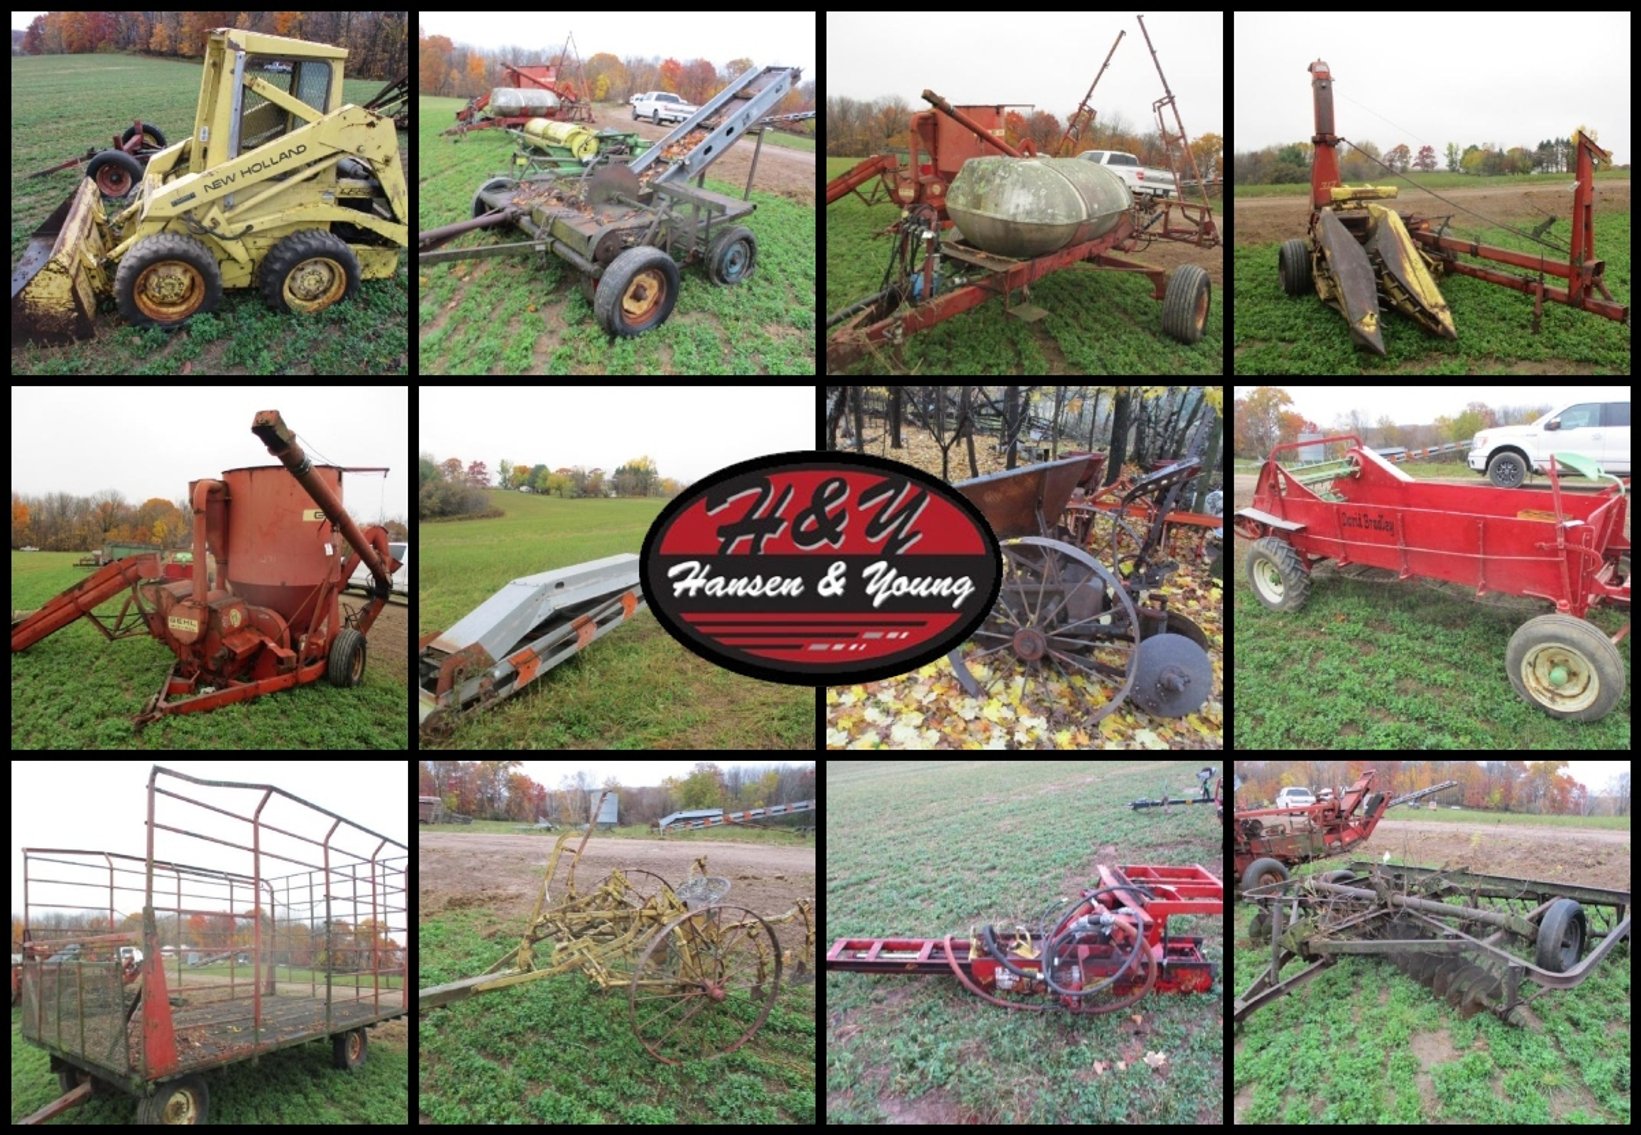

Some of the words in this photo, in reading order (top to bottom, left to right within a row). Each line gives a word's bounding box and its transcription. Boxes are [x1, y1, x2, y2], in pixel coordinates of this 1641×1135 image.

[203, 173, 236, 193] NEW
[240, 144, 307, 178] HOLLAND
[169, 615, 197, 628] GEHL
